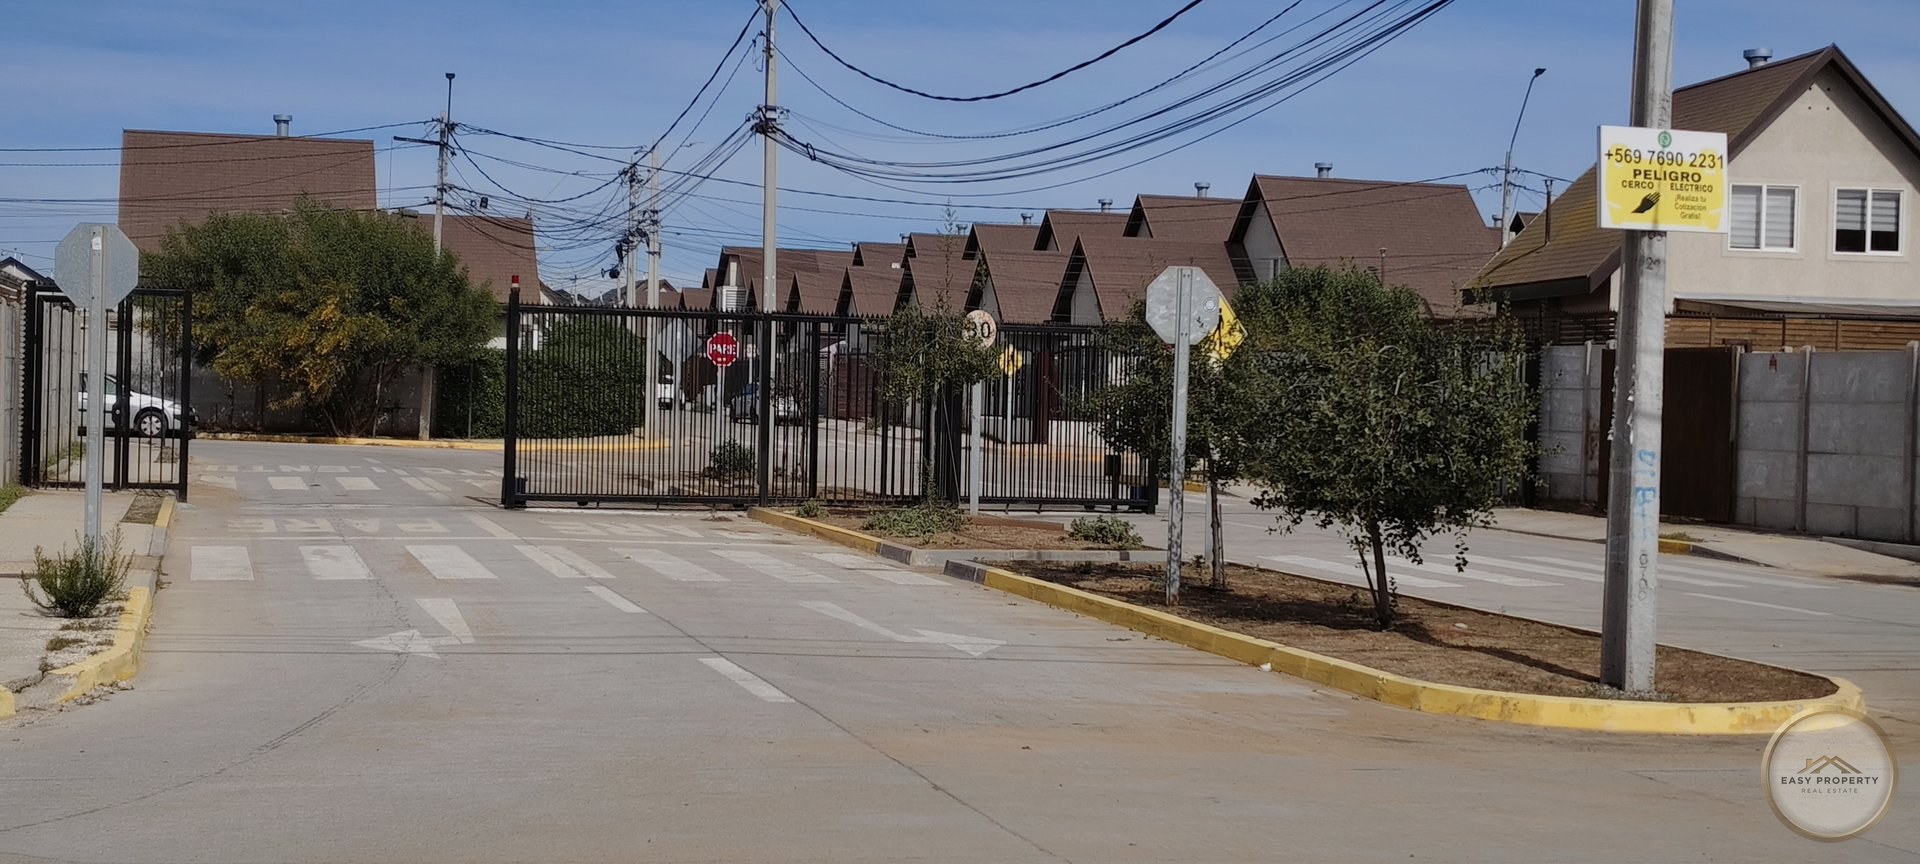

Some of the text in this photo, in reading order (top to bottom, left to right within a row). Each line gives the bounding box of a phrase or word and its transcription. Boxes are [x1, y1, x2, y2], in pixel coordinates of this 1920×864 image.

[1605, 148, 1724, 170] +569 7690 2231
[1633, 169, 1702, 183] PELIGRO
[1621, 180, 1713, 193] CERCO ELECTRICO
[964, 321, 991, 339] 30
[709, 343, 737, 355] PARE
[226, 518, 451, 533] PARE
